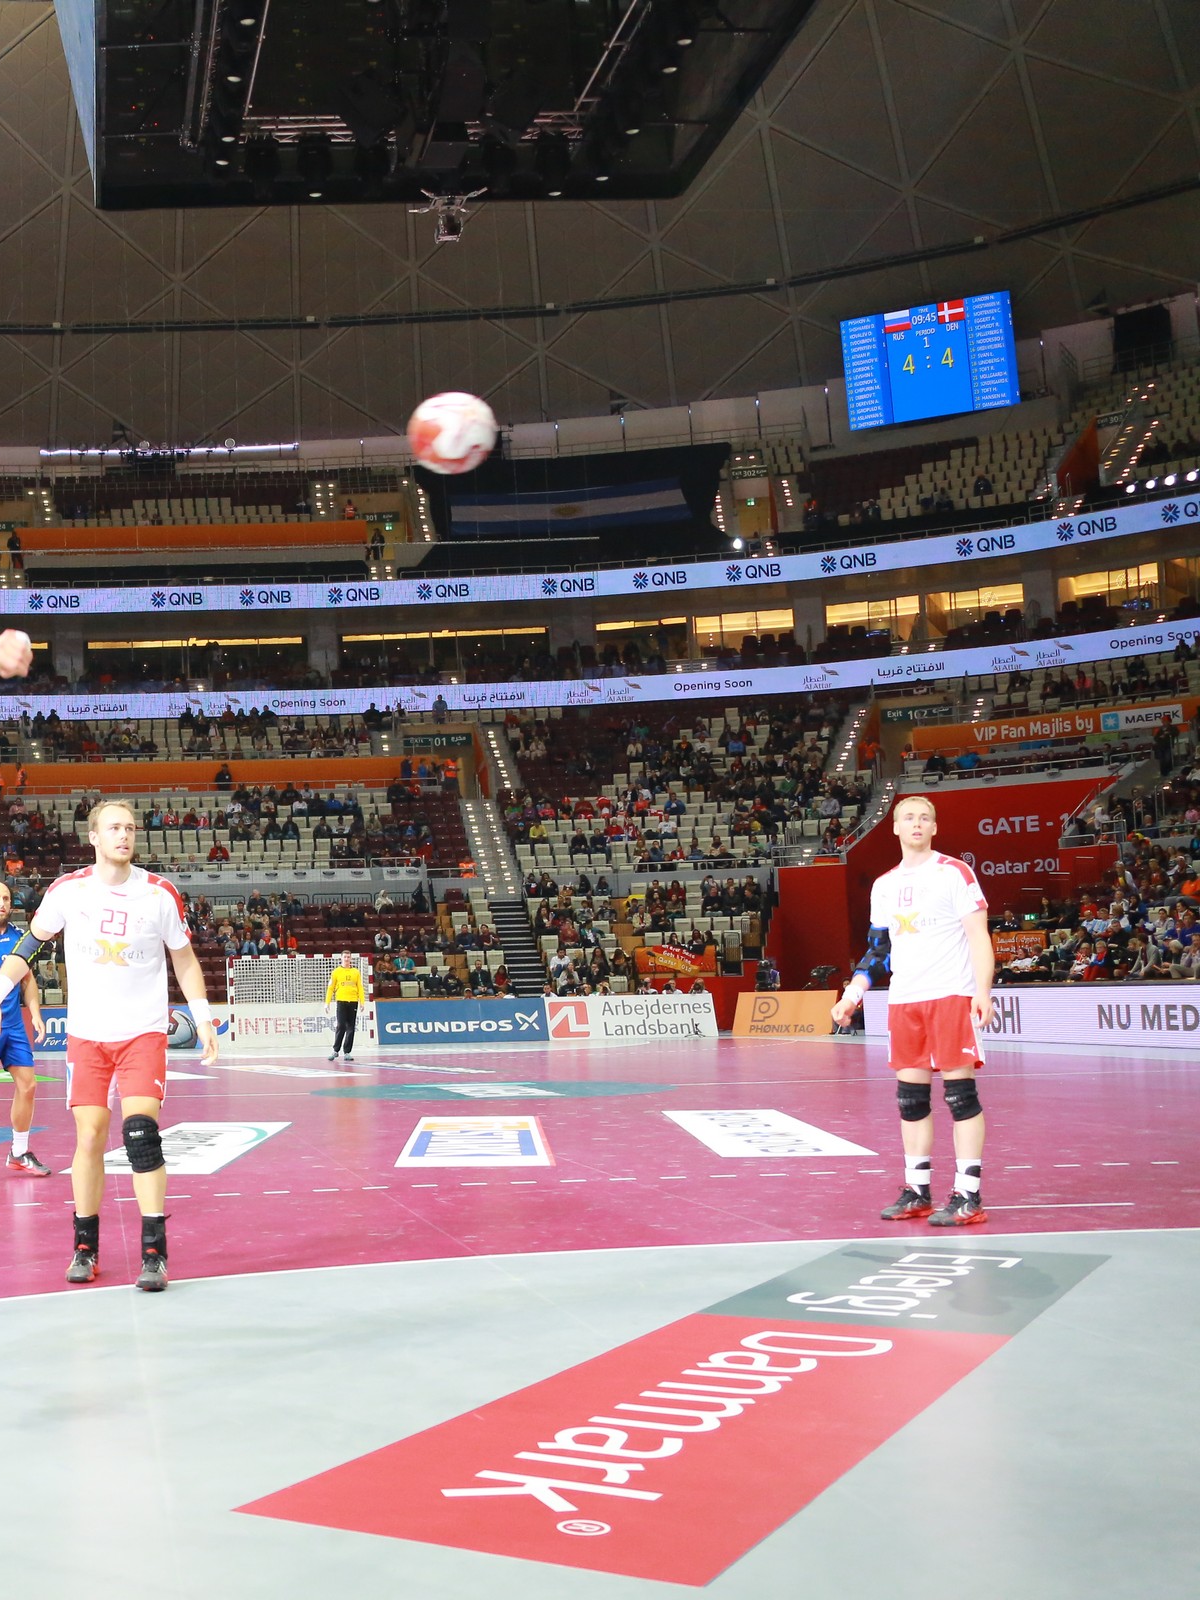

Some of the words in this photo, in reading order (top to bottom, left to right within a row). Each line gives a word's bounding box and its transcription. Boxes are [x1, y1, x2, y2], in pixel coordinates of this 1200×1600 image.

[912, 312, 936, 325] 09:45
[915, 328, 935, 337] PERIOD
[946, 322, 959, 332] DEN
[893, 331, 905, 341] RUS
[923, 337, 930, 348] 1
[902, 354, 915, 375] 4
[941, 347, 954, 368] 4
[1078, 518, 1117, 536] QNB
[977, 535, 1015, 552] QNB
[840, 553, 877, 571] QNB
[652, 571, 687, 586] QNB
[745, 564, 781, 579] QNB
[435, 584, 469, 598] QNB
[560, 578, 594, 593] QNB
[46, 595, 80, 609] QNB
[169, 592, 203, 606] QNB
[257, 591, 291, 604] QNB
[346, 588, 380, 602] QNB
[1110, 635, 1163, 650] Opening
[1167, 630, 1200, 642] Soon
[674, 681, 721, 693] Opening
[724, 678, 753, 689] Soon
[271, 698, 316, 710] Opening
[319, 697, 346, 708] Soon
[887, 710, 902, 719] Exit
[973, 726, 998, 742] VIP
[1001, 723, 1026, 740] Fan
[1029, 716, 1071, 738] Majlis
[1075, 715, 1094, 733] by
[978, 815, 1040, 836] GATE
[980, 860, 1031, 877] Qatar
[898, 886, 913, 908] 19
[100, 908, 128, 937] 23
[601, 999, 712, 1019] Arbejdernes
[1097, 1003, 1131, 1030] NU
[1141, 1004, 1200, 1031] MED
[385, 1019, 514, 1035] GRUNDFOS
[603, 1018, 700, 1037] Landsbank
[749, 1024, 791, 1034] PHØNIX
[793, 1024, 814, 1033] TAG
[43, 1036, 62, 1047] For
[786, 1252, 1023, 1319] Energi
[440, 1330, 894, 1513] Danmark
